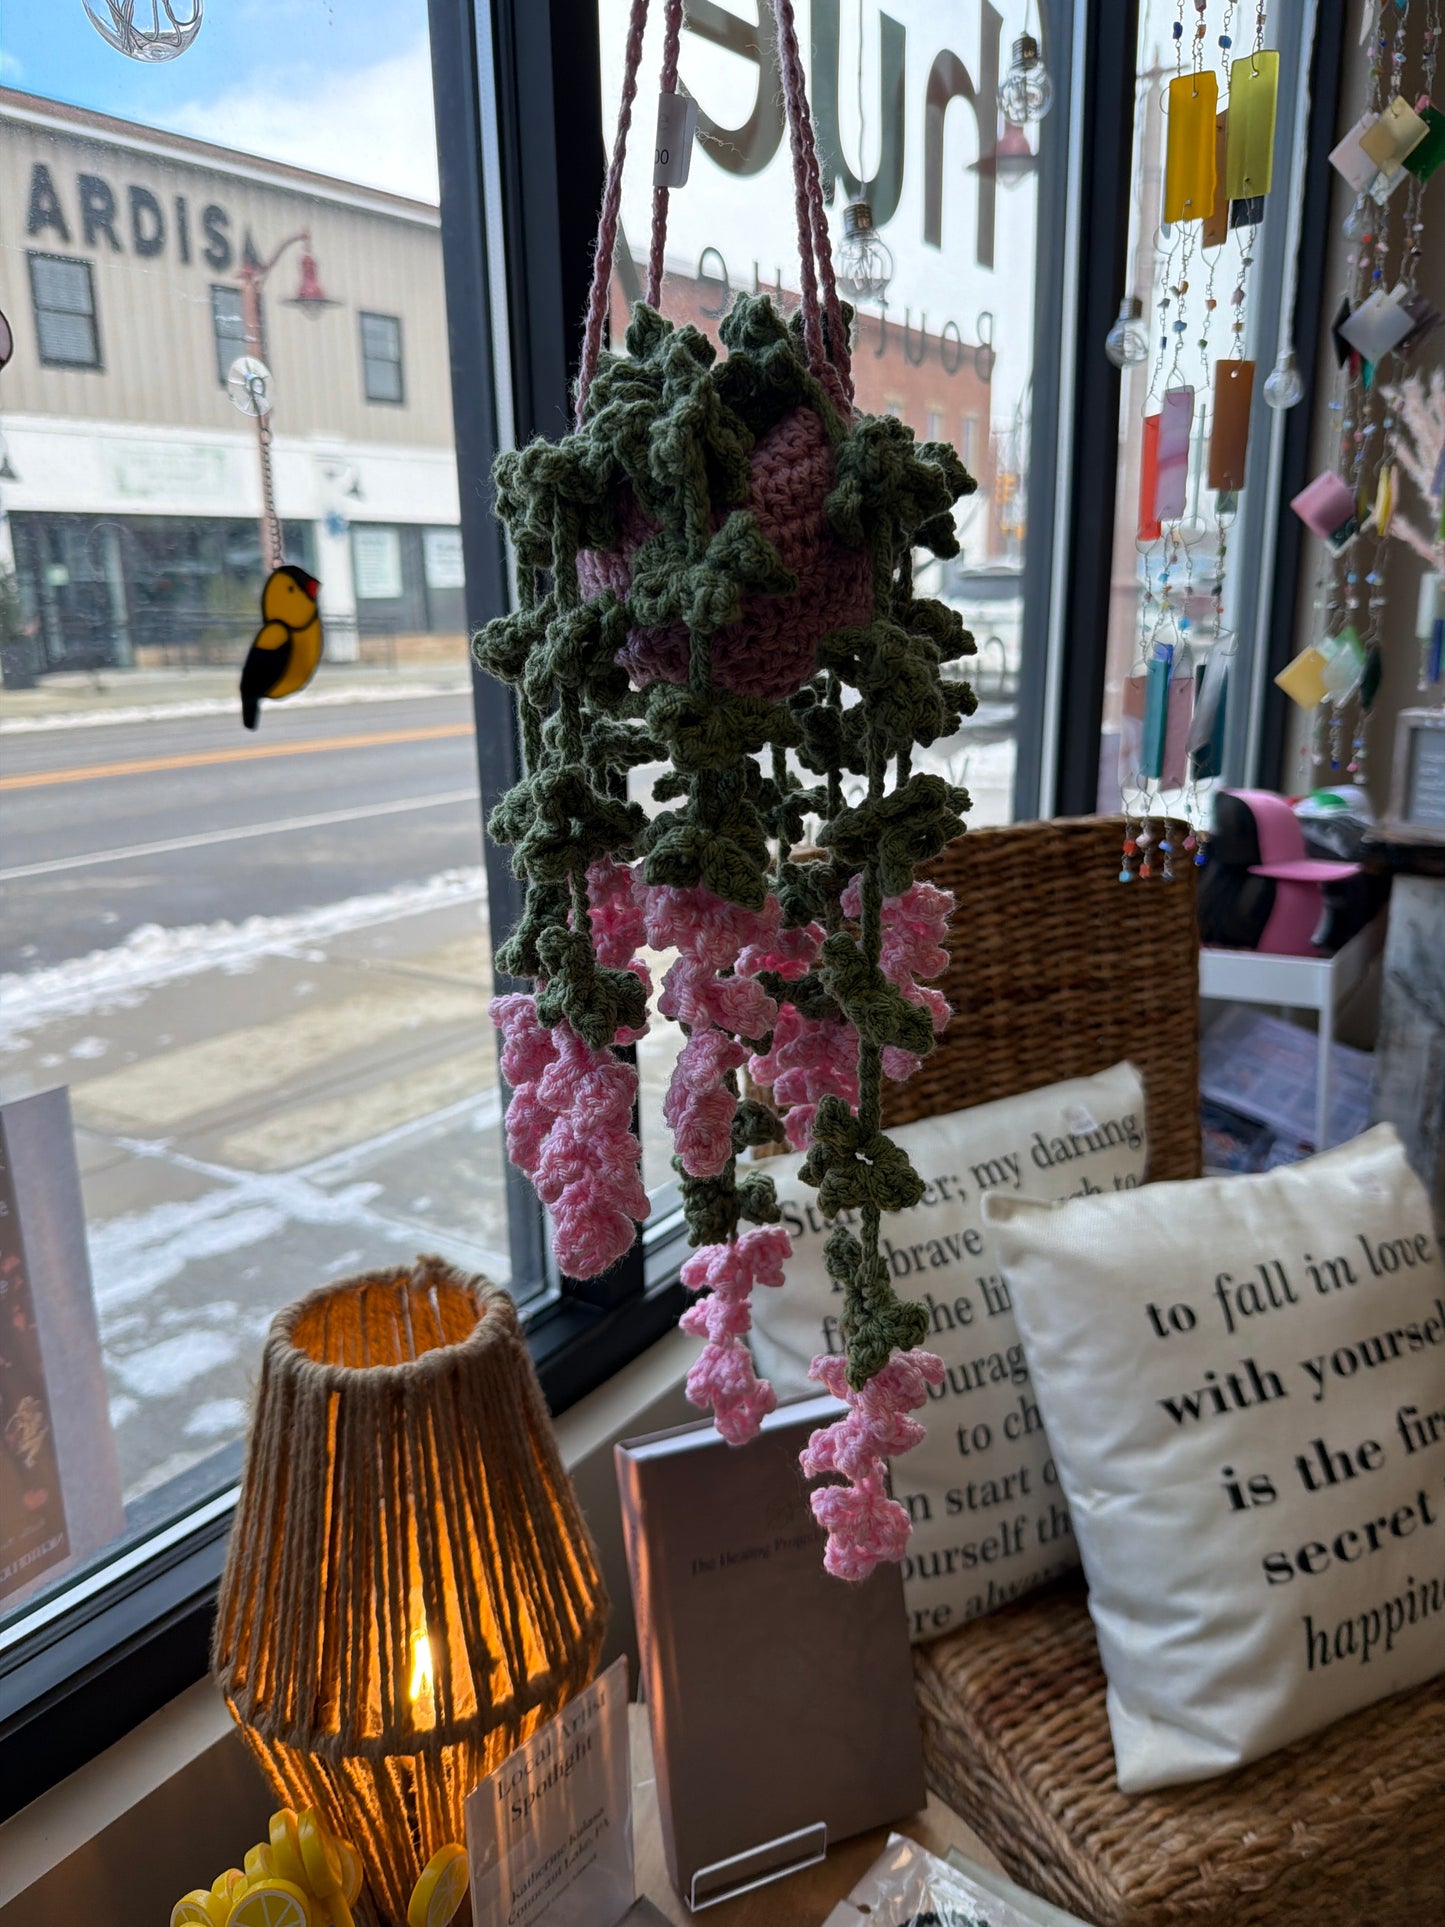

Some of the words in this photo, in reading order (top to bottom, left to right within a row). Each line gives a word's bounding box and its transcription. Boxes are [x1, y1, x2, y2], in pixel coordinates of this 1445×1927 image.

[969, 1150, 1021, 1190] my
[884, 1228, 983, 1278] brave
[1146, 1302, 1196, 1338] to
[1213, 1259, 1298, 1334] fall
[1303, 1253, 1357, 1295] in
[1356, 1232, 1433, 1277] love
[925, 1293, 975, 1336] he
[1157, 1357, 1288, 1425] with
[1300, 1299, 1445, 1401] yoursel
[956, 1423, 993, 1456] to
[1221, 1465, 1277, 1512] is
[1295, 1438, 1385, 1492] the
[1396, 1406, 1445, 1454] fir
[945, 1465, 1031, 1516] start
[1261, 1489, 1436, 1586] secret
[1303, 1575, 1445, 1671] happin
[498, 1737, 551, 1801] Local
[511, 1735, 592, 1822] Spotlight
